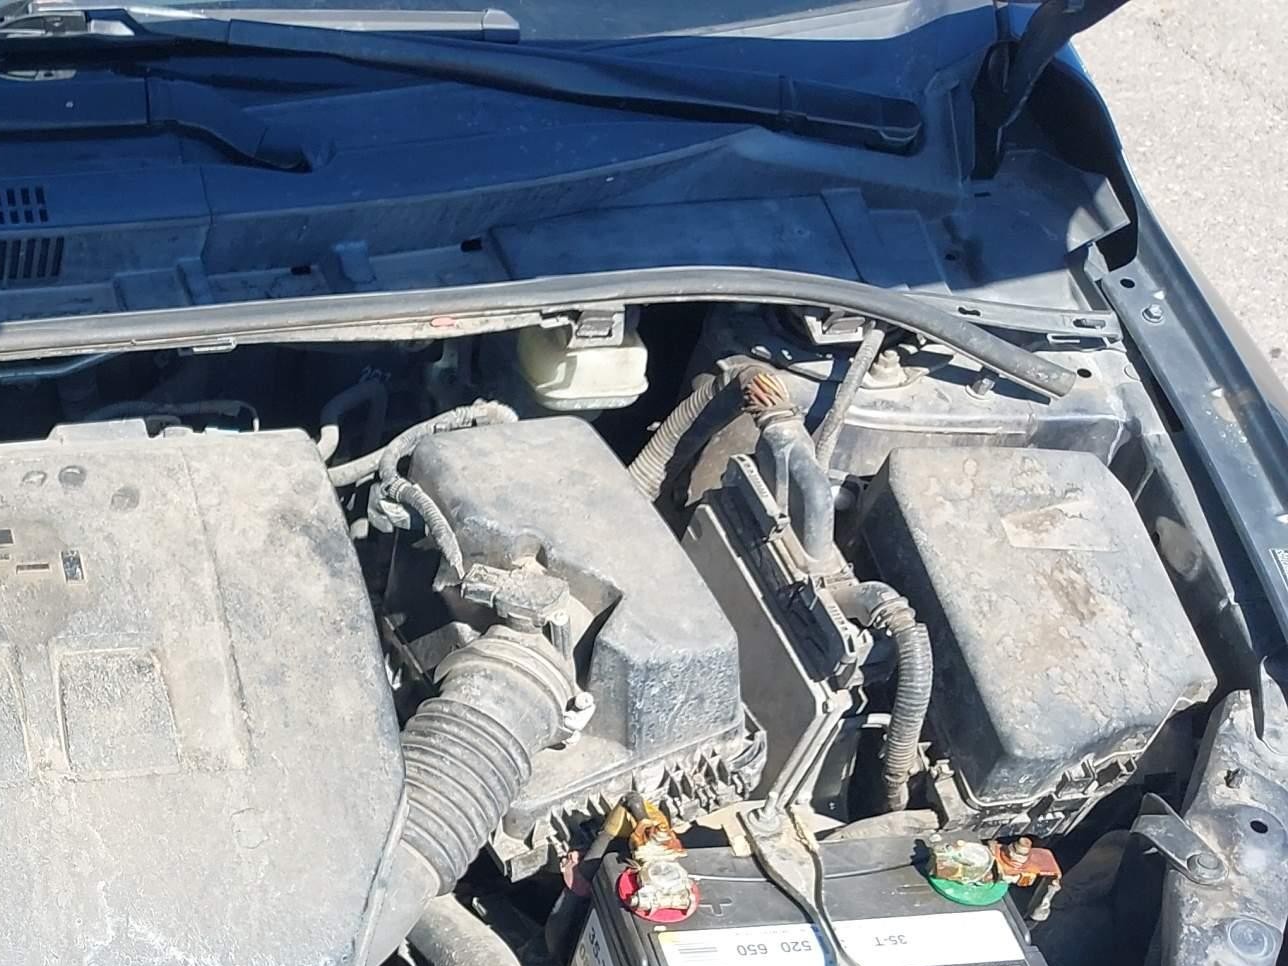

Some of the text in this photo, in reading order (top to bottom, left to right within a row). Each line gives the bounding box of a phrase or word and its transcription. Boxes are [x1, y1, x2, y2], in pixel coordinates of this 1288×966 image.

[872, 934, 907, 946] 35-T
[736, 939, 811, 956] 520 650
